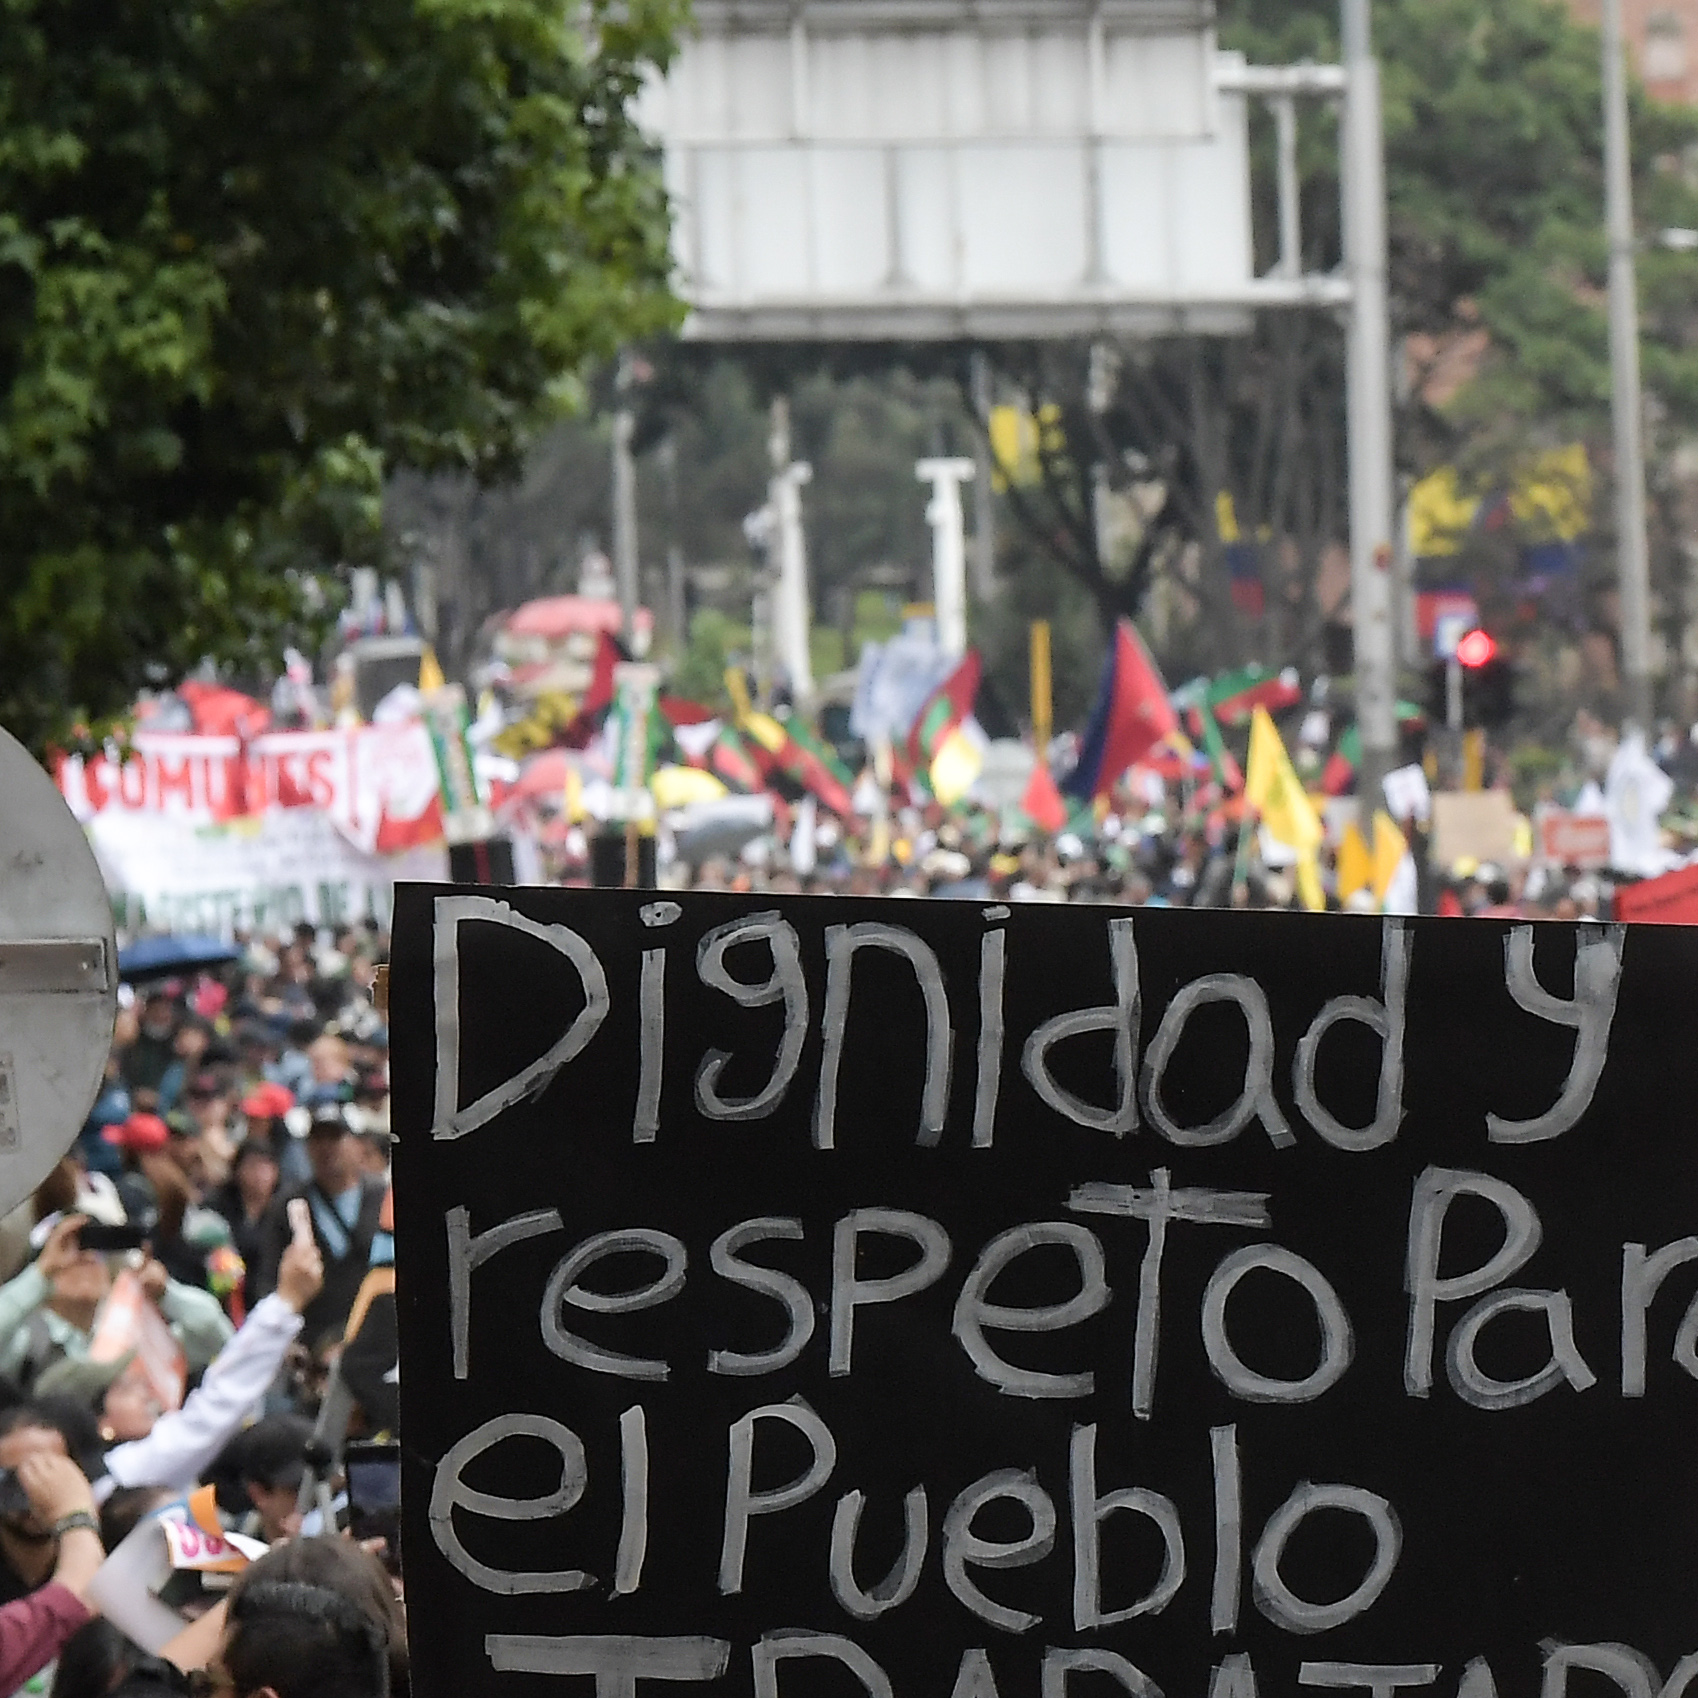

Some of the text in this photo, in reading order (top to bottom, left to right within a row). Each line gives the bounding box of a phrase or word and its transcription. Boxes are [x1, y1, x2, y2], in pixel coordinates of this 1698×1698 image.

[432, 893, 1627, 1151] Dignidad y
[445, 1166, 1354, 1418] respeto
[427, 1394, 1402, 1633] el Pueblo
